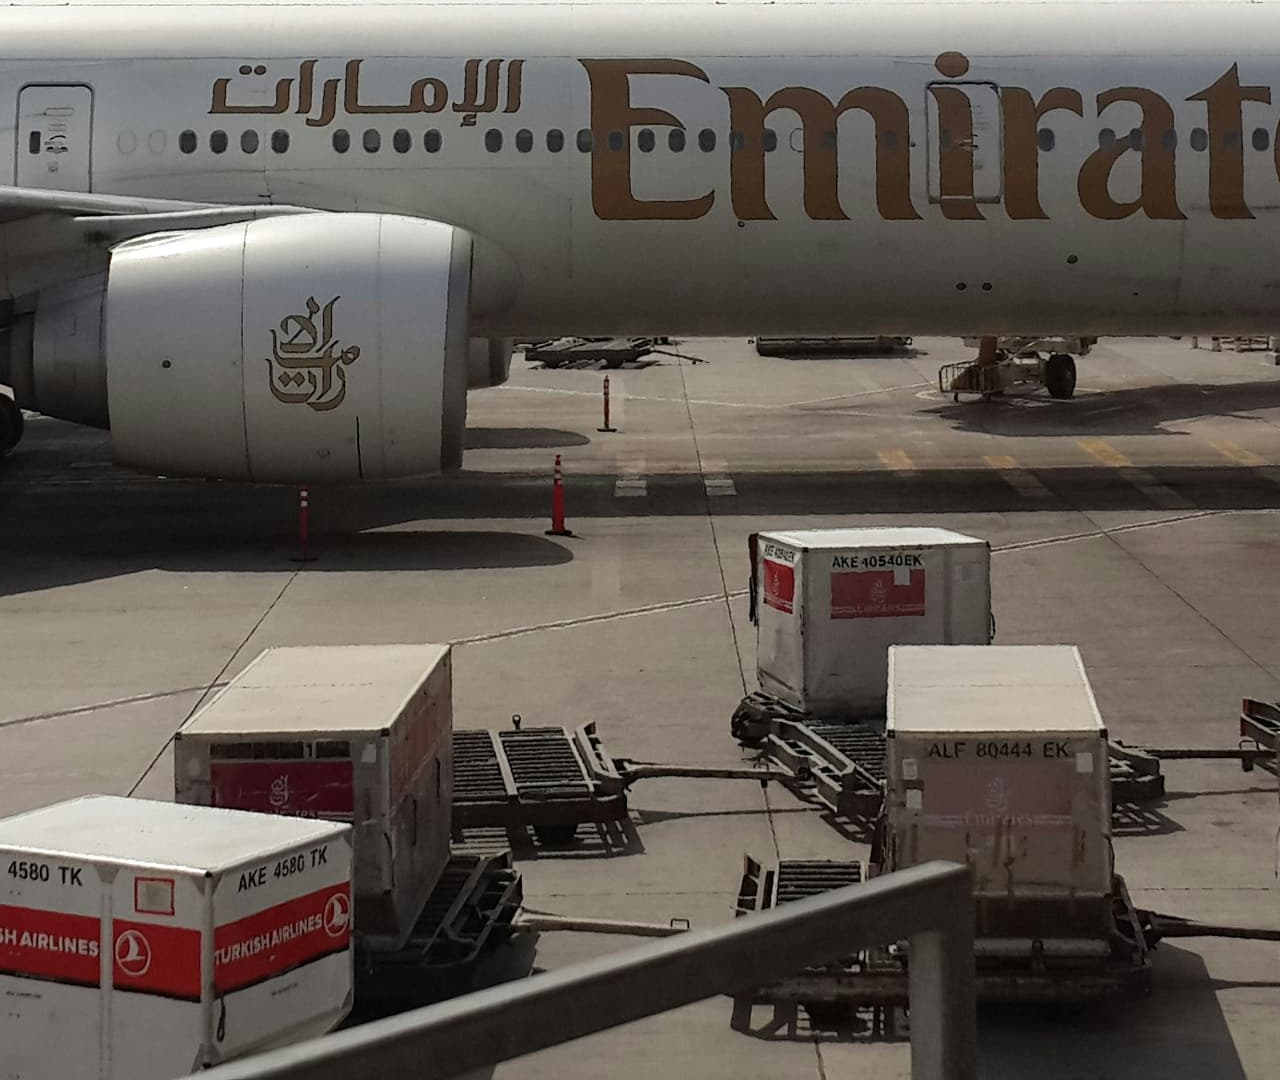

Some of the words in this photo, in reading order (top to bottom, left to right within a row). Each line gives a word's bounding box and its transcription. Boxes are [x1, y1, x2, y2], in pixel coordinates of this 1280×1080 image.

[208, 58, 524, 128] الإمارات
[832, 555, 858, 568] AKE
[928, 742, 966, 758] ALF
[976, 742, 1032, 759] 80444
[1043, 742, 1070, 758] EK
[8, 860, 50, 882] 4580
[59, 866, 83, 887] TK
[237, 866, 267, 892] AKE
[273, 852, 305, 879] 4580
[310, 845, 328, 868] TK
[20, 930, 100, 957] AIRLINES
[214, 934, 271, 966] TURKISH
[271, 913, 323, 945] AIRLINES
